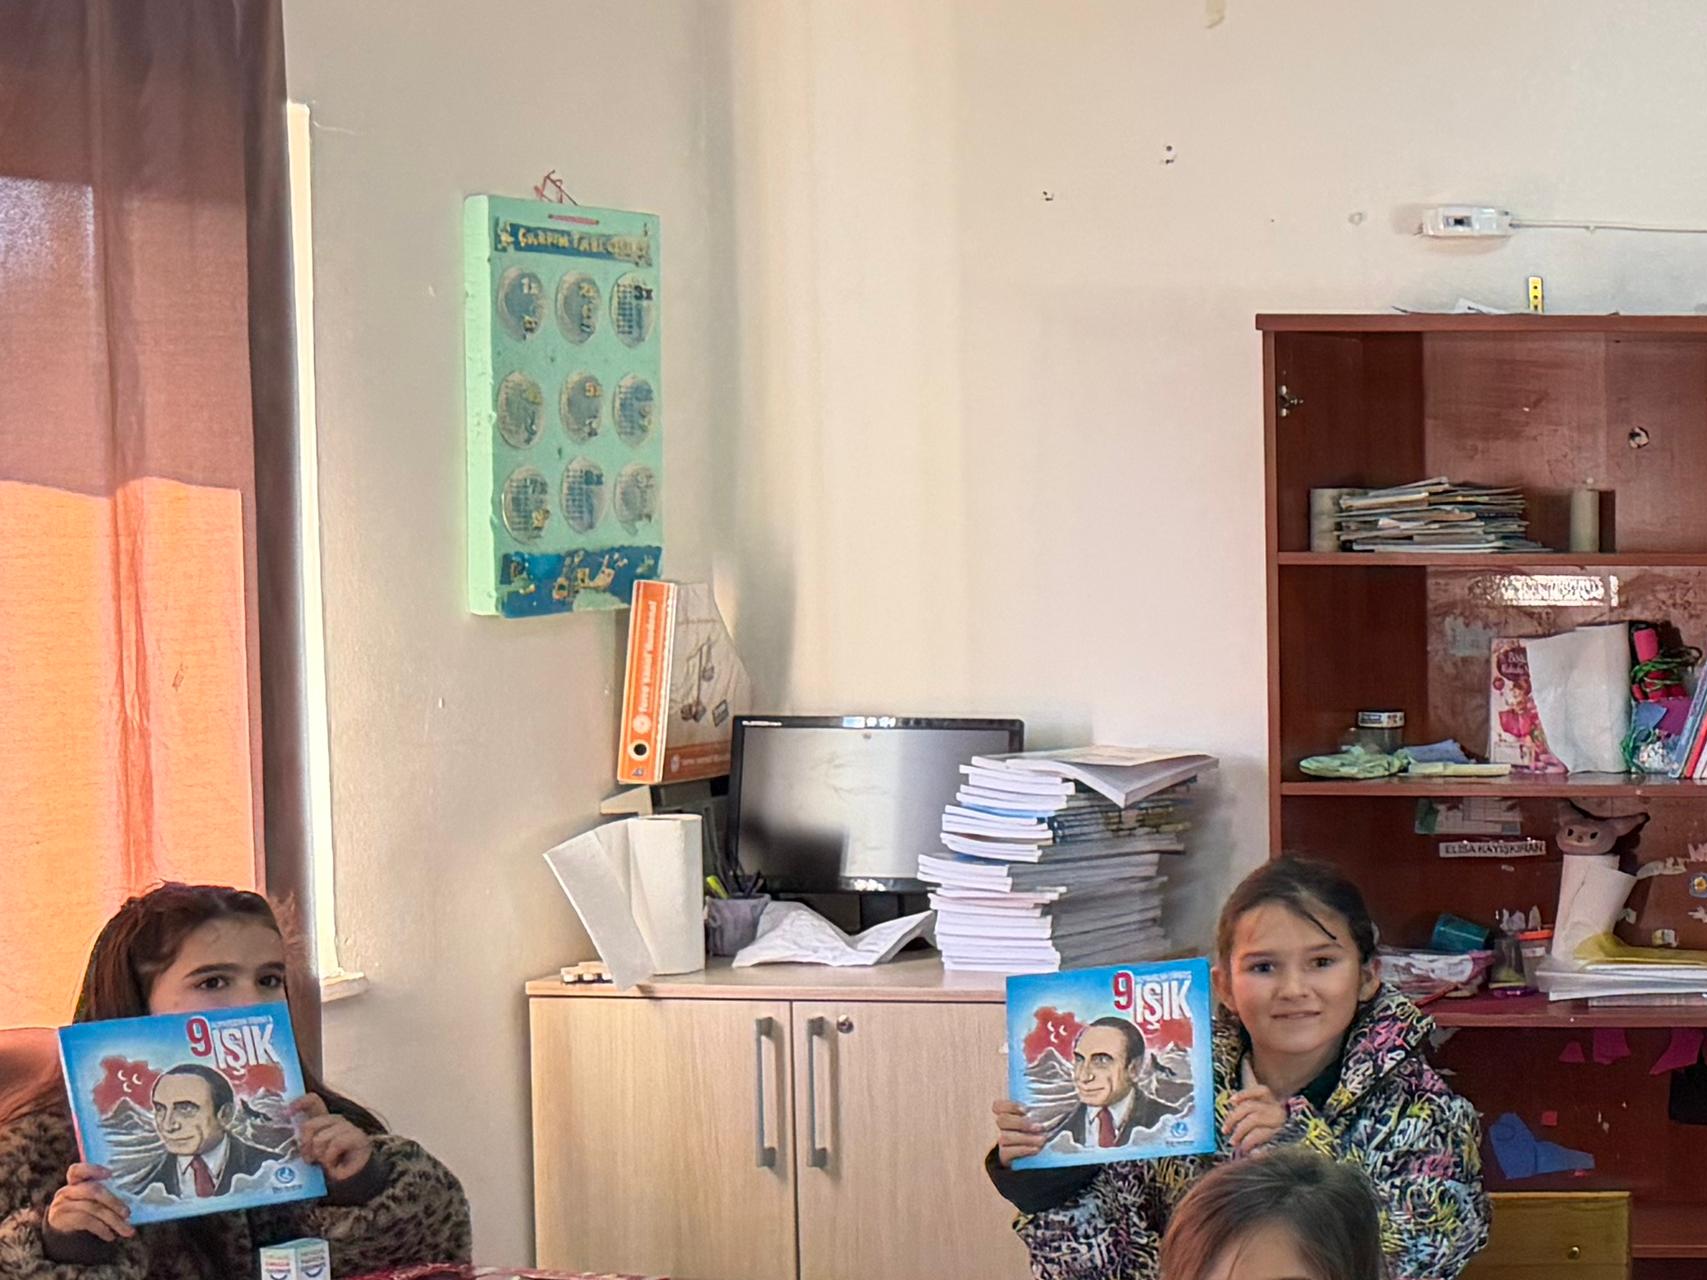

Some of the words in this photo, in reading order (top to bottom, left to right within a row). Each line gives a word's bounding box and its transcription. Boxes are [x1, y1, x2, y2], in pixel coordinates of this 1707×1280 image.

[1113, 971, 1135, 1012] 9
[1134, 978, 1193, 1031] IŞIK
[185, 1016, 214, 1058] 9
[211, 1023, 281, 1077] IŞIK
